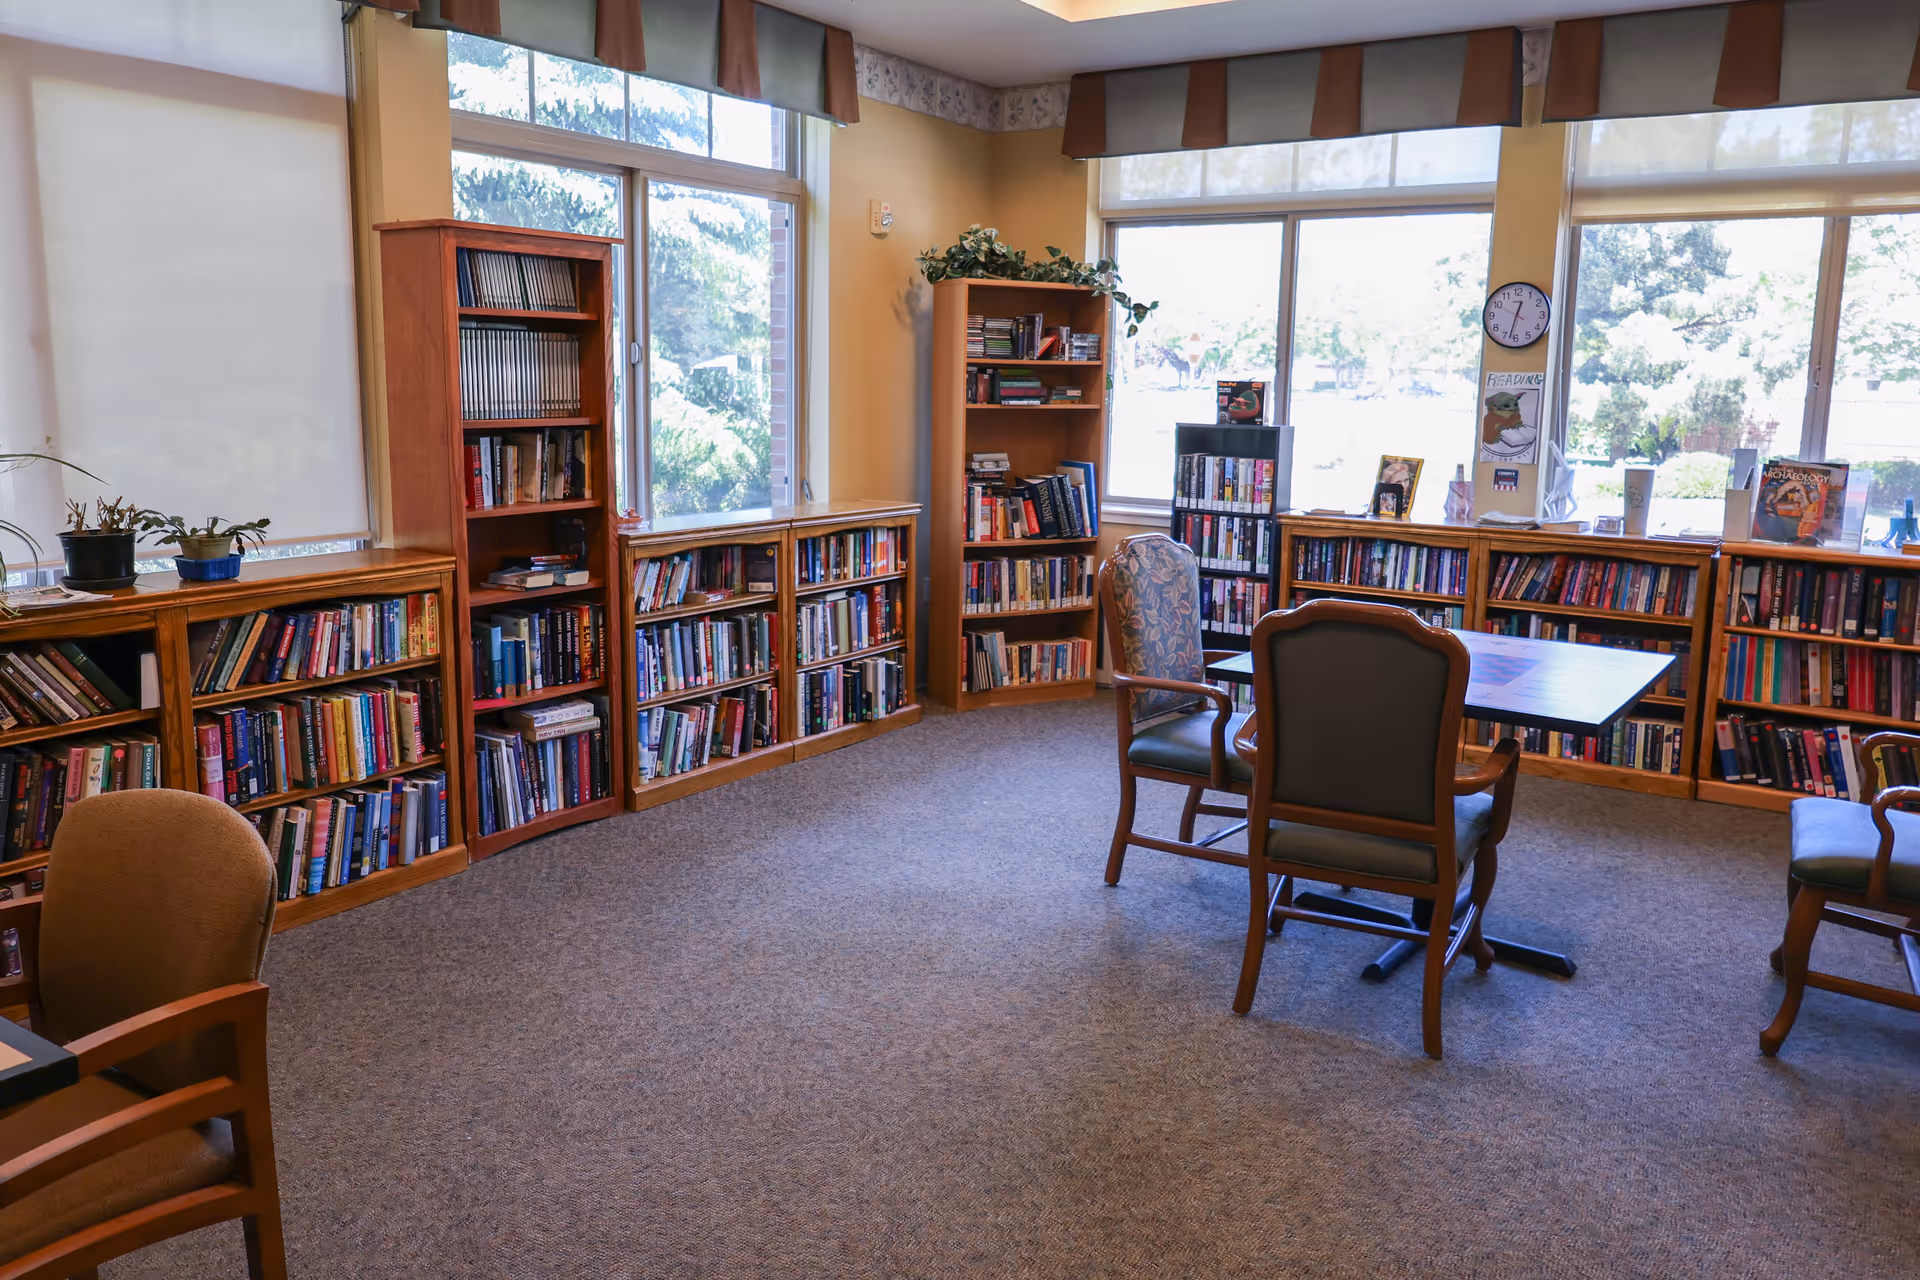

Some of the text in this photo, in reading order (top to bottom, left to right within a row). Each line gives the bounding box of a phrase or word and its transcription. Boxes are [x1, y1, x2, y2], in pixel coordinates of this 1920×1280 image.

[1502, 292, 1510, 300] 11
[1514, 288, 1523, 296] 12
[1494, 300, 1502, 308] 10
[1536, 299, 1542, 308] 2
[1539, 311, 1546, 319] 3
[1512, 334, 1519, 342] 6
[1487, 374, 1543, 387] READING
[1762, 470, 1830, 484] ARCHAEOLOGY
[1038, 484, 1054, 520] SPANISH
[583, 626, 592, 671] ECLIPSE
[224, 715, 233, 733] DAVID
[146, 772, 150, 781] ON
